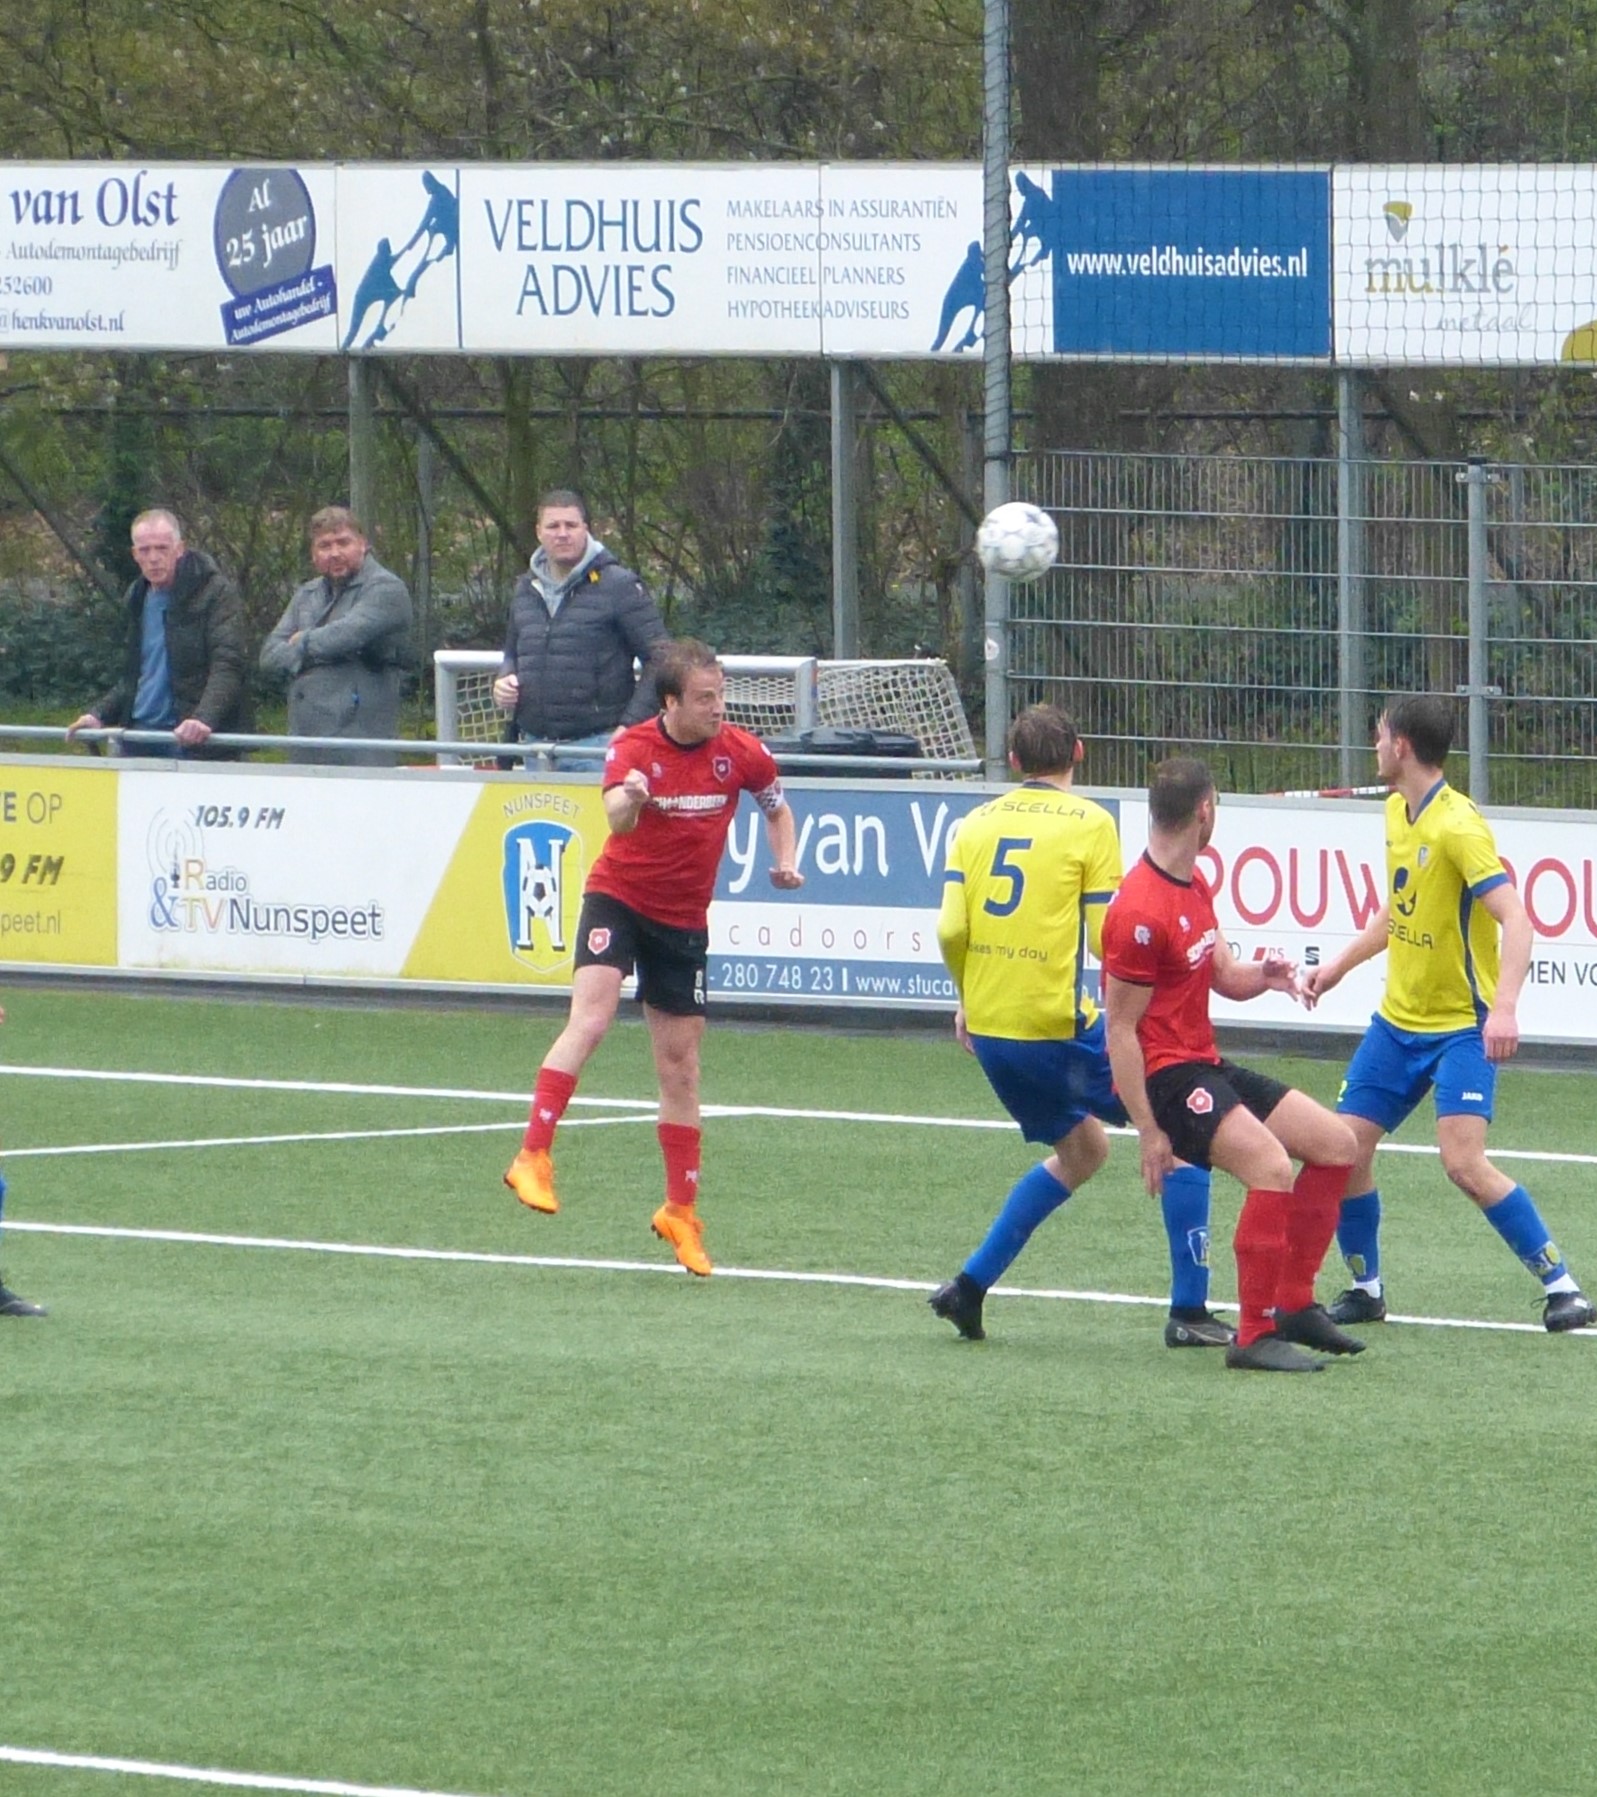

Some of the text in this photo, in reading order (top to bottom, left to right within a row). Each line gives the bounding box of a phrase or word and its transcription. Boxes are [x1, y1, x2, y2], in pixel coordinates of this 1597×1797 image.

[12, 171, 179, 227] van Olst
[248, 178, 272, 212] Al
[726, 195, 958, 220] MAKELAARS IN ASSURANTIËN
[226, 215, 308, 269] 25 jaar
[484, 198, 704, 254] VELDHUIS
[5, 238, 182, 271] Autodemontagebedrijf
[726, 232, 922, 253] PENSIOENCONSULTANTS
[726, 266, 906, 286] FINANCIEEL PLANNERS
[1066, 246, 1308, 278] www.veldhuisadvies.nl
[1364, 243, 1515, 294] mulklé
[234, 275, 316, 321] uw Autohandel
[516, 265, 676, 319] ADVIES
[727, 299, 910, 320] HYPOTHEEKADVISEURS
[1436, 301, 1538, 333] metaal
[0, 791, 62, 825] E OP
[194, 804, 286, 830] 105.9 FM
[502, 792, 581, 819] NUNSPEET
[728, 812, 760, 893] y
[21, 855, 65, 885] FM
[184, 859, 247, 891] Radio
[983, 837, 1033, 917] 5
[0, 910, 61, 937] peet.nl
[229, 898, 382, 940] Nunspeet
[729, 914, 921, 953] cadoors
[996, 945, 1015, 960] my
[1018, 946, 1049, 963] day
[722, 962, 759, 988] 280
[766, 964, 802, 990] 748
[811, 966, 834, 992] 23
